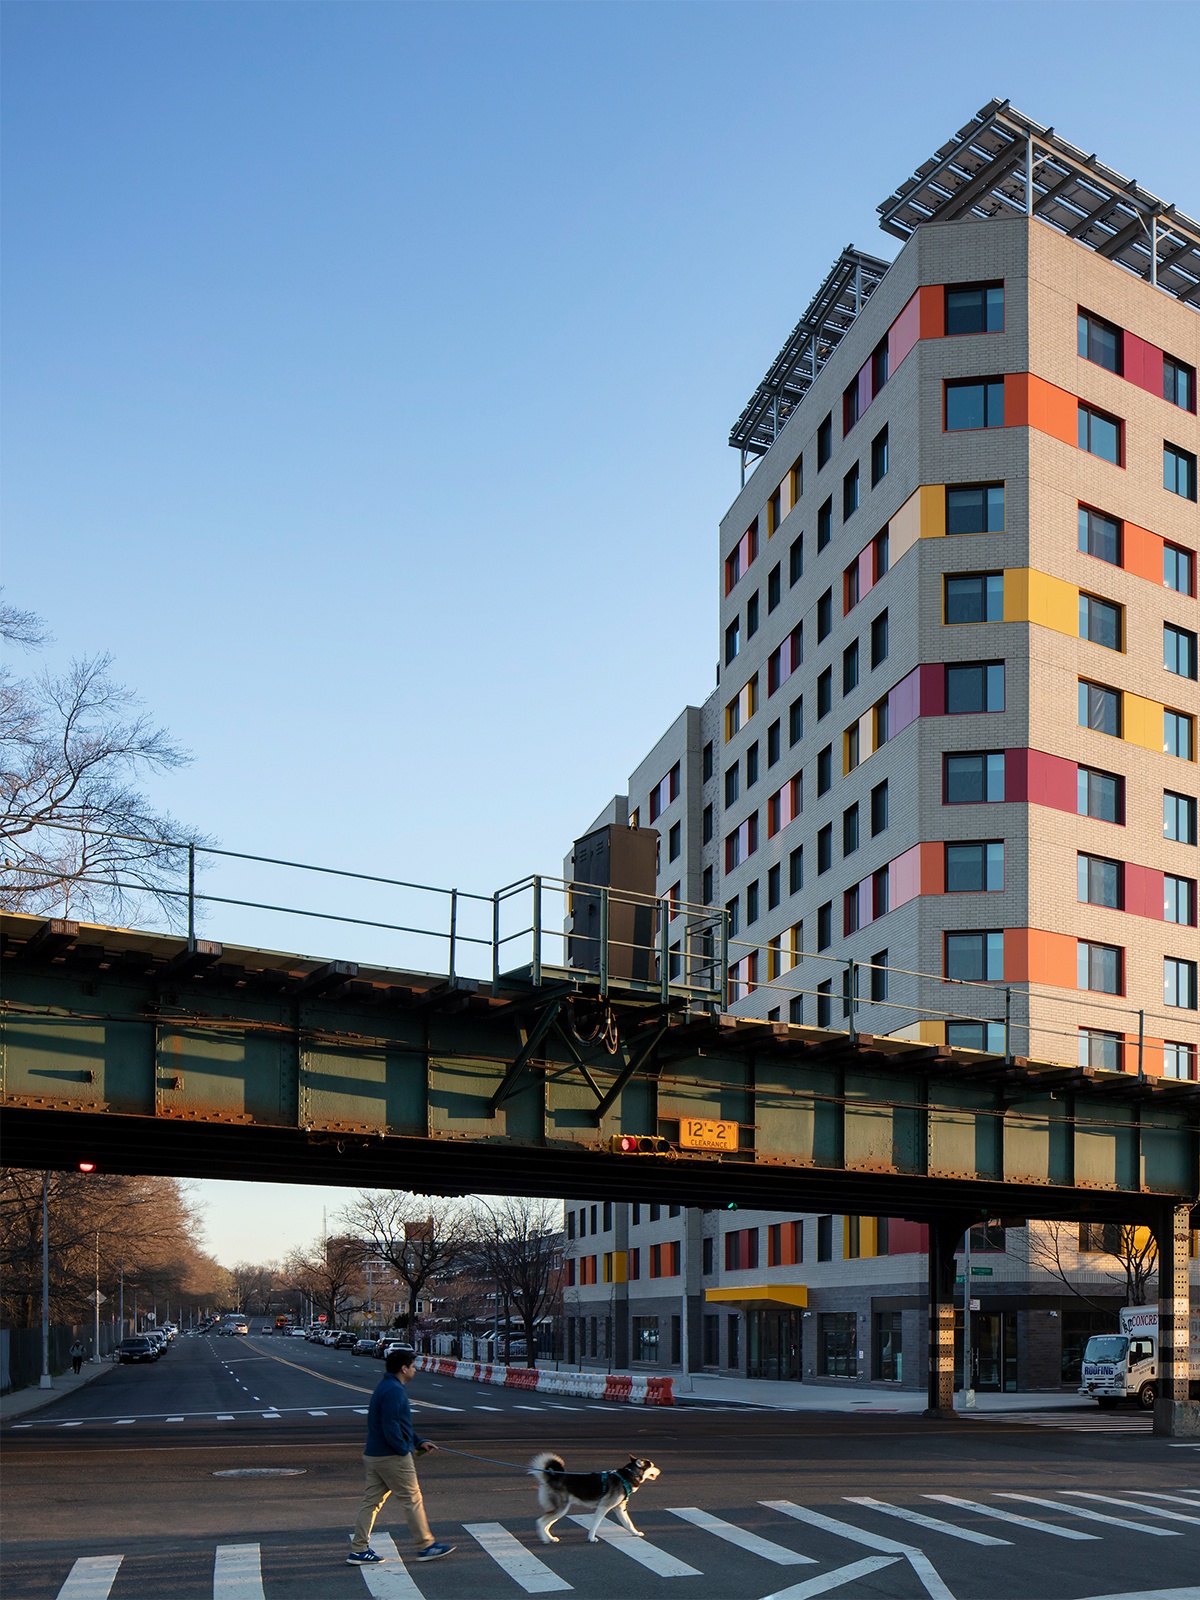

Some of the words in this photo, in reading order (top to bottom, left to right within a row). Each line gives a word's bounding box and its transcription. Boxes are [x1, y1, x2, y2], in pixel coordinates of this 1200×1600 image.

[690, 1139, 728, 1148] CLEARANCE
[1132, 1314, 1158, 1327] CONCRE
[1084, 1366, 1114, 1375] ROOFING
